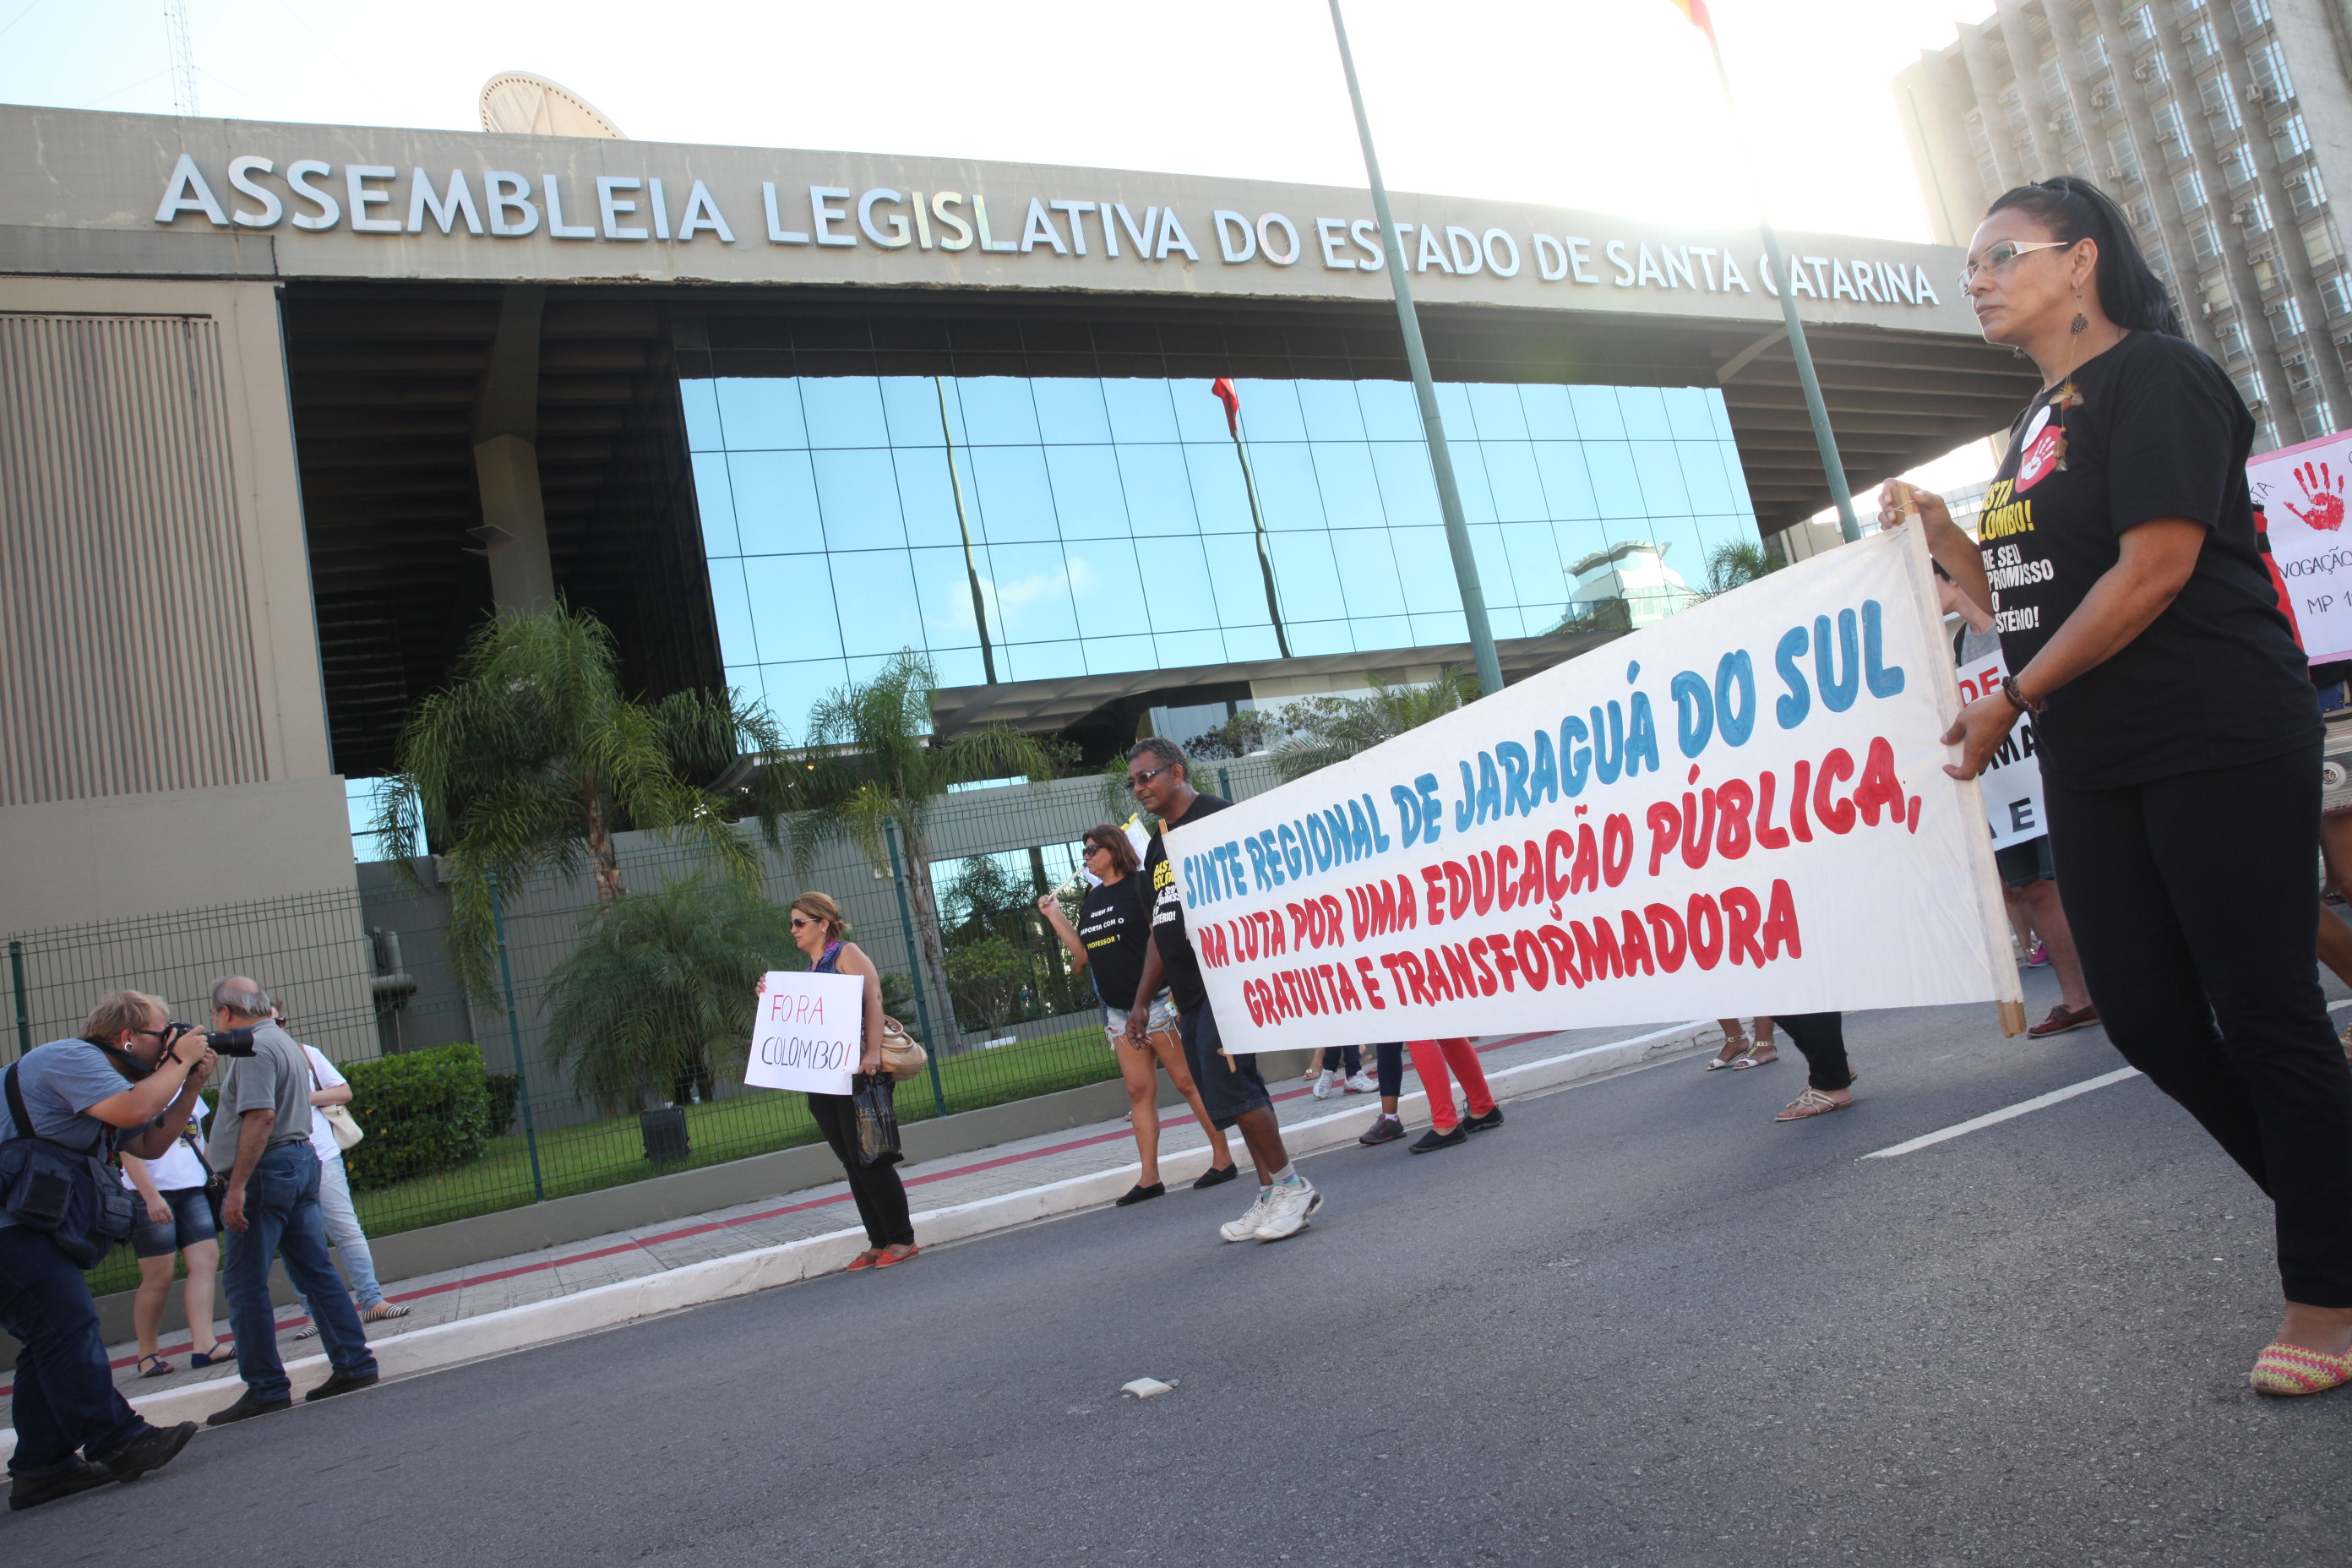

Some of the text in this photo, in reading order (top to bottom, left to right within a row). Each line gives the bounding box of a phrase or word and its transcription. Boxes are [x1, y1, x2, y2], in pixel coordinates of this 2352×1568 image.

[154, 154, 1940, 306] ASSEMBLEIA LEGISLATIVA DO ESTADO DE SANTA CATARINA
[1997, 543, 2022, 568] SEU
[2307, 595, 2333, 615] MP
[1184, 599, 1904, 910] SINTE REGIONAL DE JARAGUÁ DO SUL
[2008, 797, 2035, 833] E
[1197, 737, 1922, 969] NA LUTA POR UMA EDUCAÇÃO PÚBLICA,
[1103, 919, 1116, 928] COM
[1243, 879, 1802, 1028] GRATUITA E TRANSFORMADORA
[771, 995, 825, 1025] FORA
[761, 1037, 852, 1071] COLOMBO!
